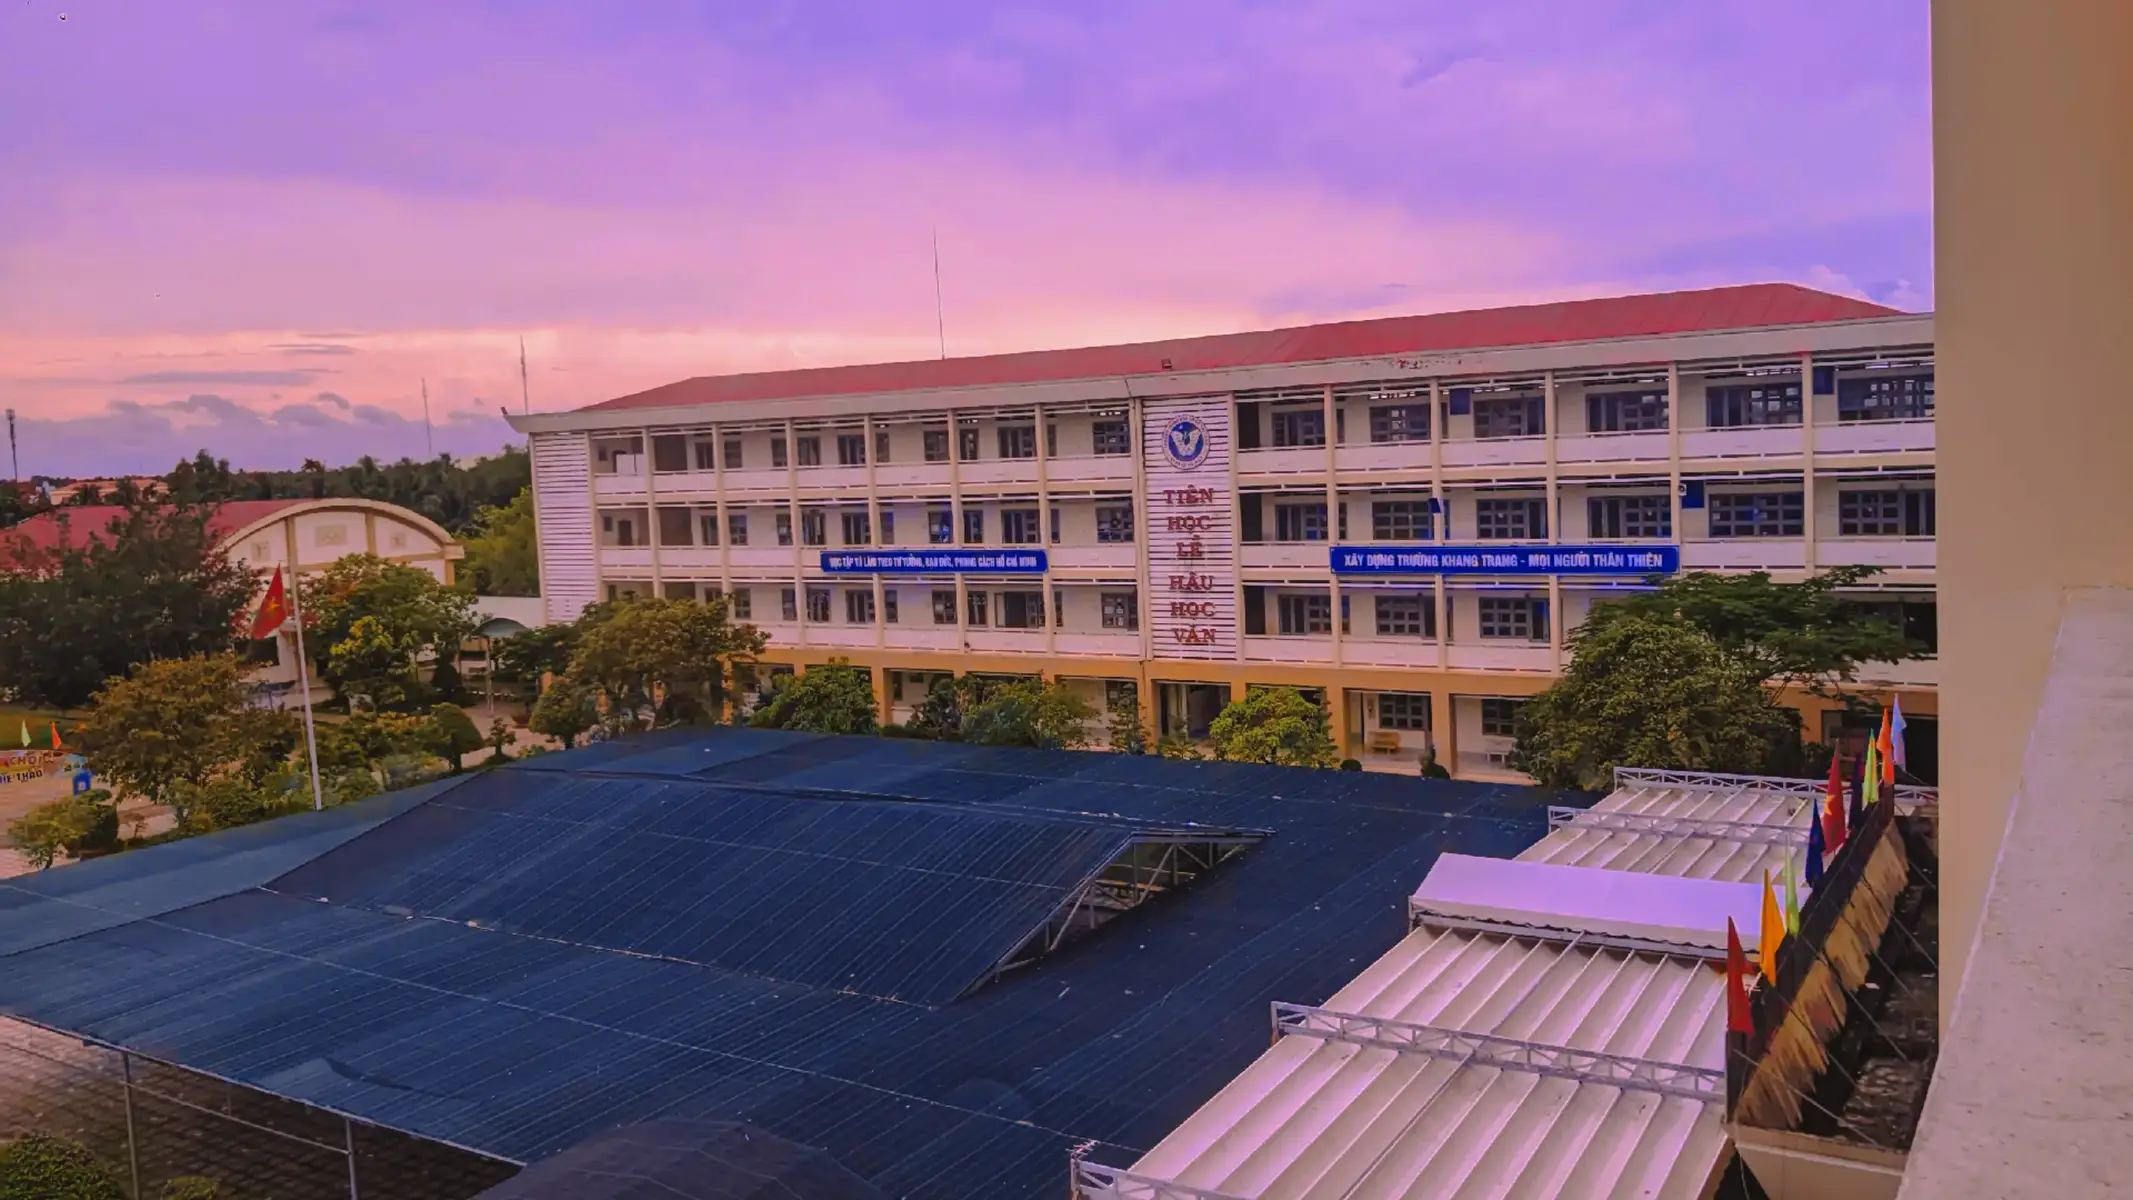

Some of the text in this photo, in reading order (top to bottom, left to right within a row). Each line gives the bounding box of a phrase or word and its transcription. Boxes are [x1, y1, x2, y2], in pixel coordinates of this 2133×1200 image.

[1163, 484, 1214, 504] TIÊN
[1166, 515, 1212, 534] HỌC
[1344, 553, 1365, 567] XÂY
[1367, 554, 1395, 569] DỰNG
[1441, 555, 1479, 568] KHANG
[1481, 555, 1518, 568] TRANG
[1528, 554, 1550, 570] MỌI
[1554, 551, 1590, 567] NGƯỜI
[1593, 552, 1624, 567] THÂN
[1627, 552, 1663, 569] THIỆN
[1170, 602, 1216, 620] HỌC
[1172, 624, 1216, 642] VĂN
